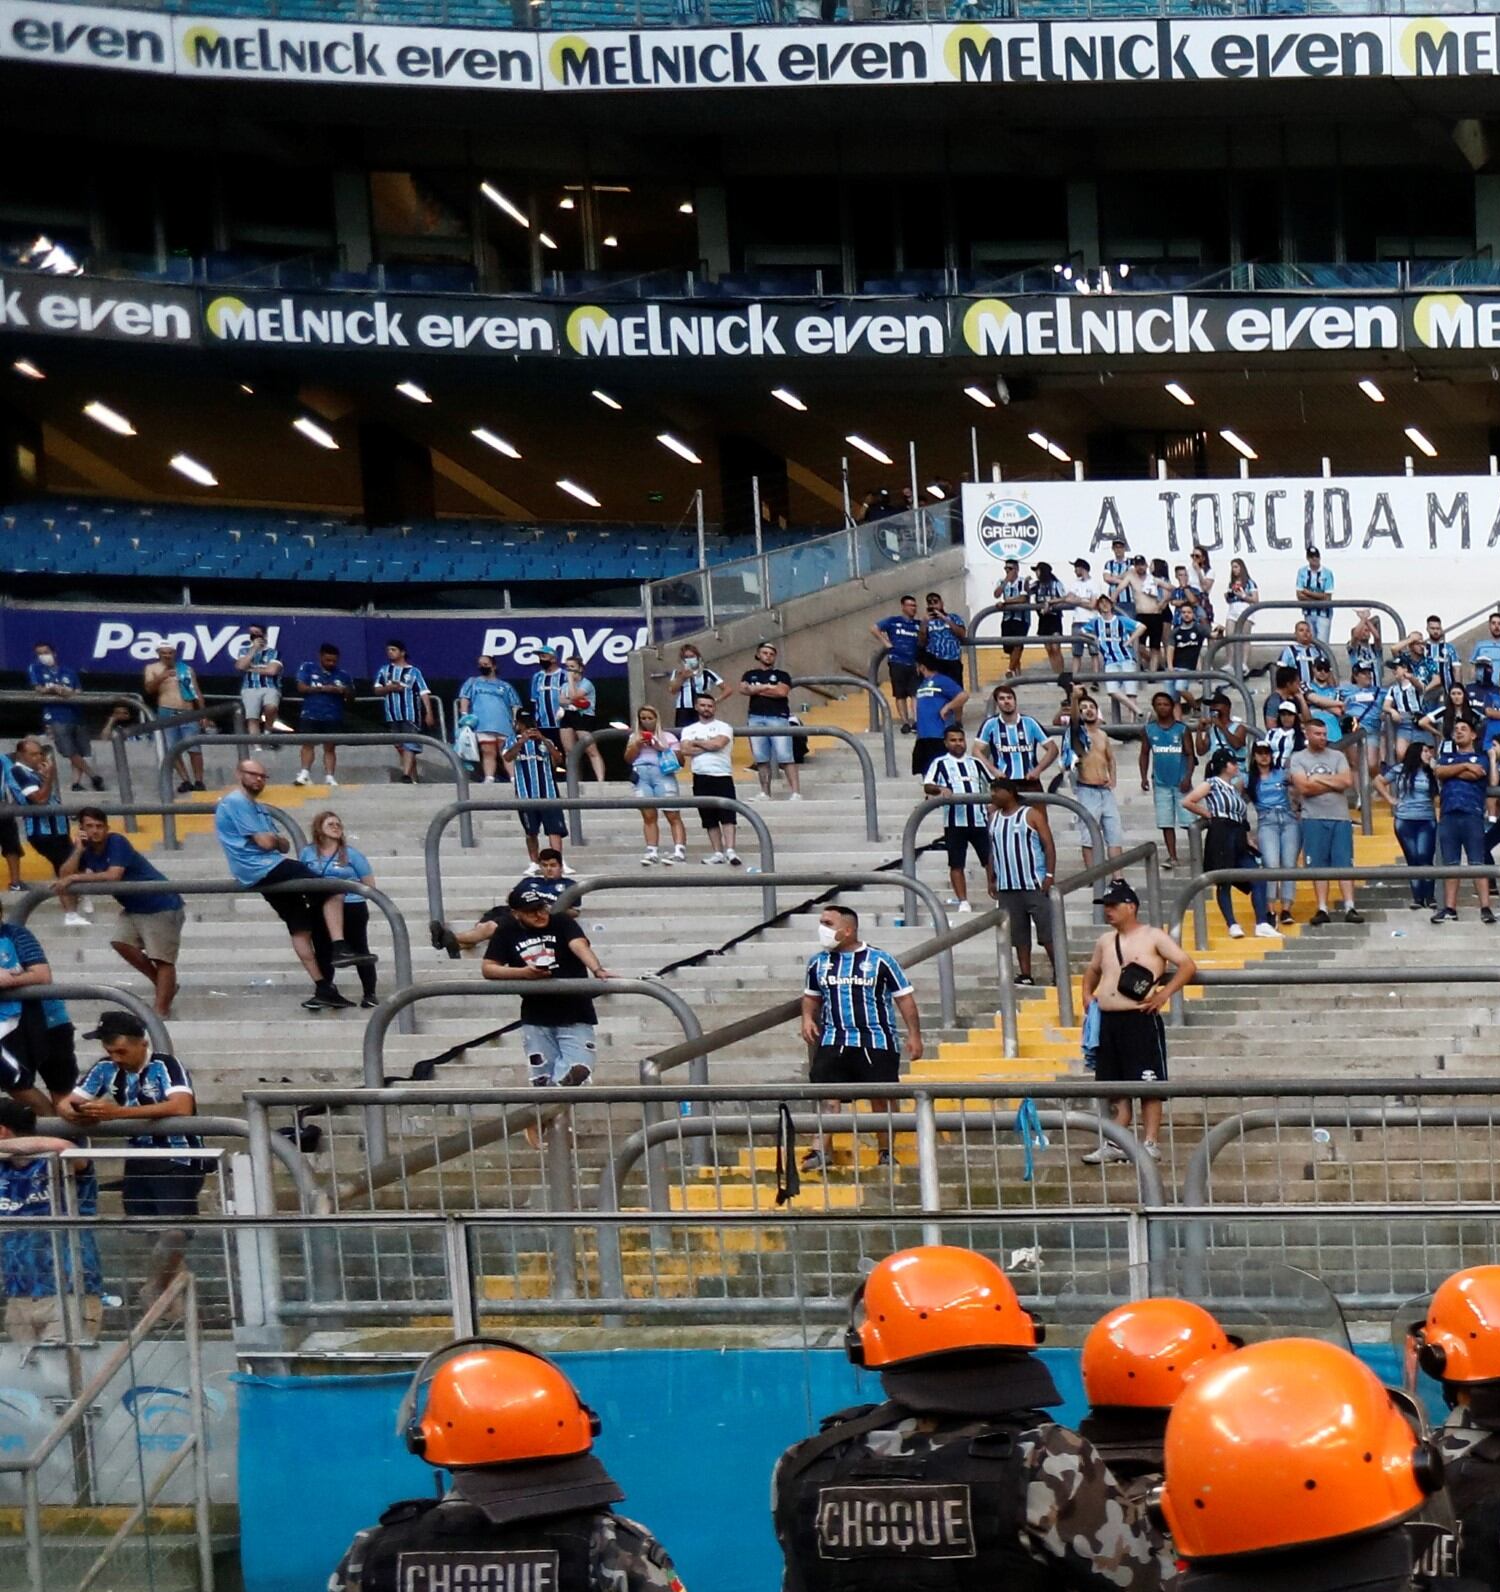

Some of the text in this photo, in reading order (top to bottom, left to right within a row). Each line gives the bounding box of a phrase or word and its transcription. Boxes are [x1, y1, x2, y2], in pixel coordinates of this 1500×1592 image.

[12, 19, 164, 64] even
[779, 41, 926, 82] even
[1212, 31, 1383, 77] even
[397, 46, 535, 83] even
[40, 296, 190, 338] even
[419, 316, 552, 357] even
[796, 309, 950, 353] even
[1227, 306, 1397, 350] even
[982, 523, 1038, 538] GRÊMIO
[1089, 496, 1131, 553] A
[1159, 488, 1403, 553] TORCIDA
[828, 975, 875, 988] Banrisul
[823, 1497, 966, 1553] CHOQUE
